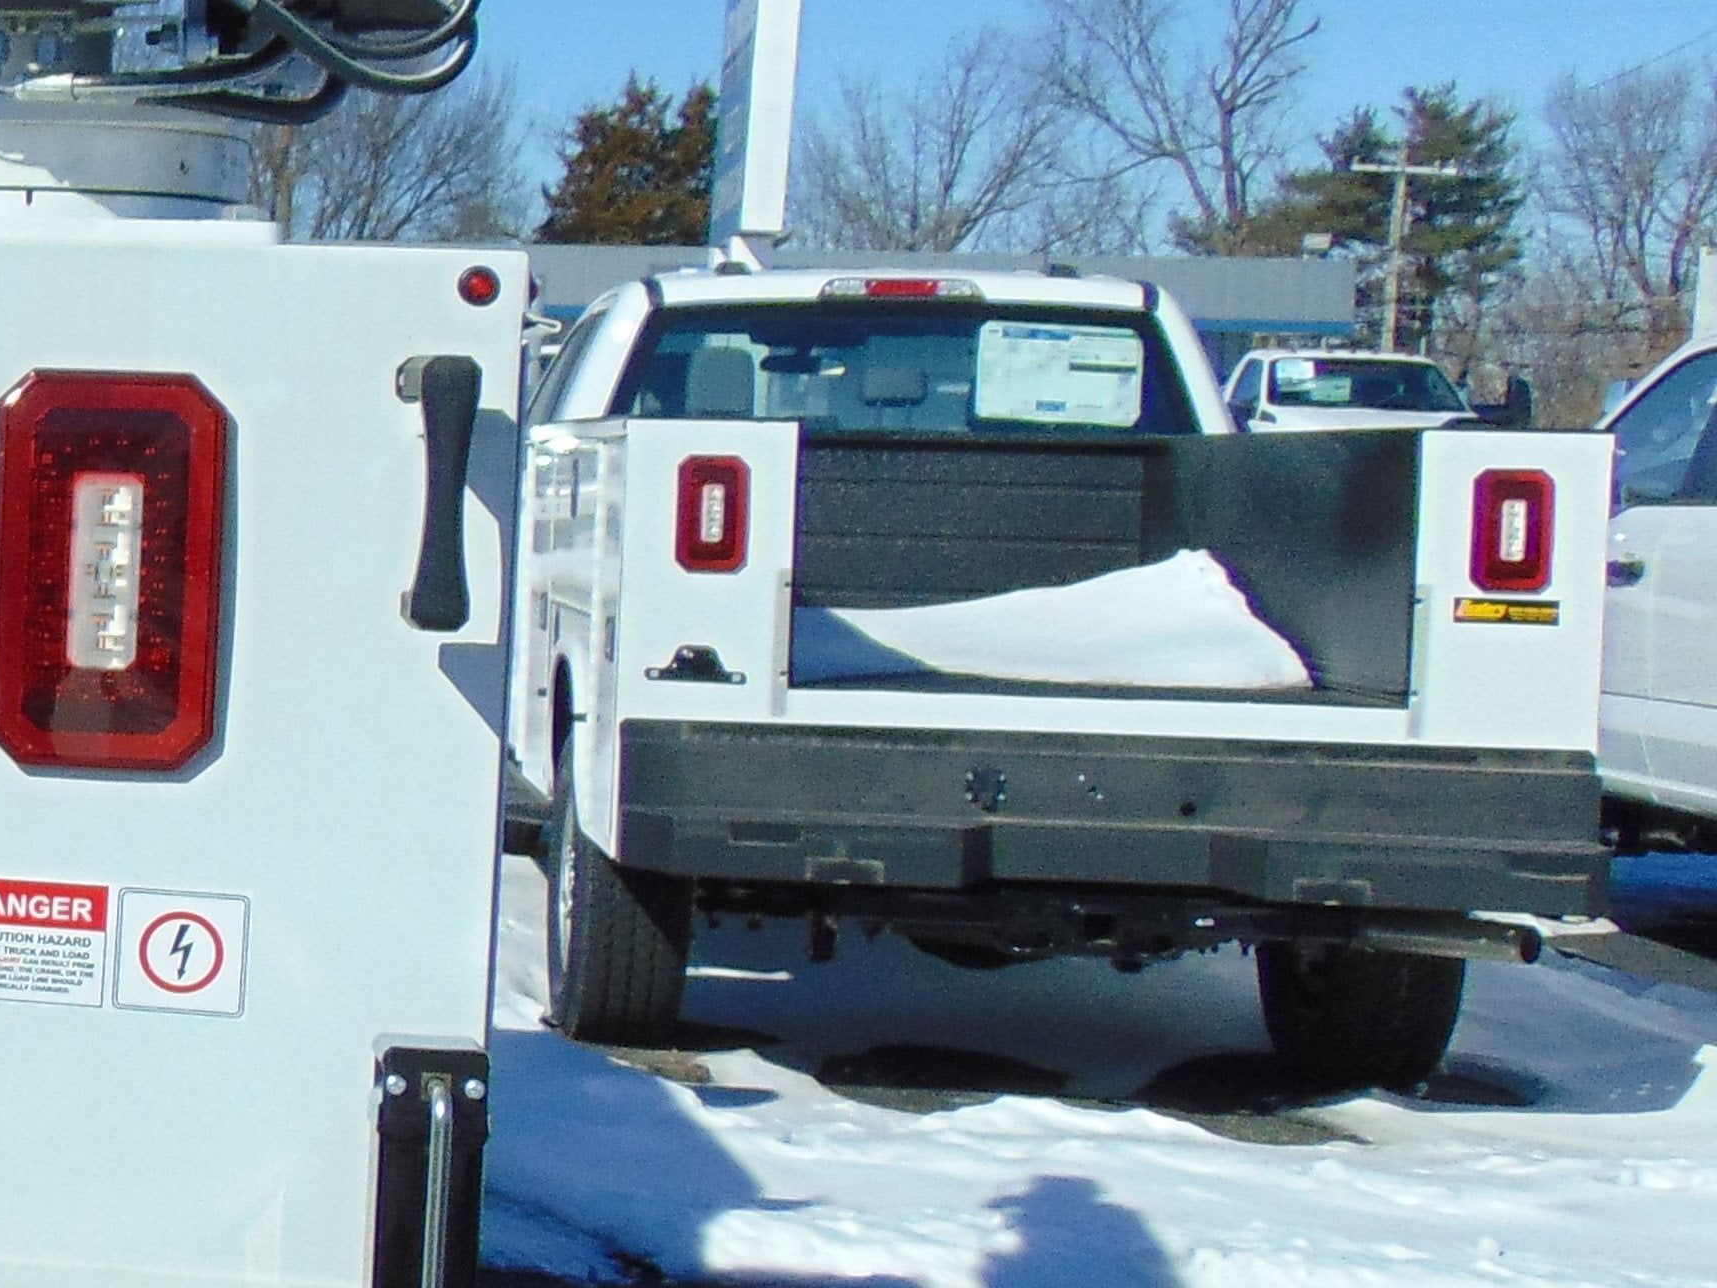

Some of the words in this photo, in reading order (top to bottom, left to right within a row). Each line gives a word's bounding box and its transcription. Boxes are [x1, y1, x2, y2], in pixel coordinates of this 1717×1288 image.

[37, 933, 91, 948] HAZARD
[4, 946, 36, 956] TRUCK
[40, 948, 58, 957] AND
[62, 950, 90, 959] LOAD
[23, 957, 38, 965] CAN
[41, 959, 70, 968] RESULT
[72, 961, 94, 969] FROM
[79, 971, 94, 979] THE
